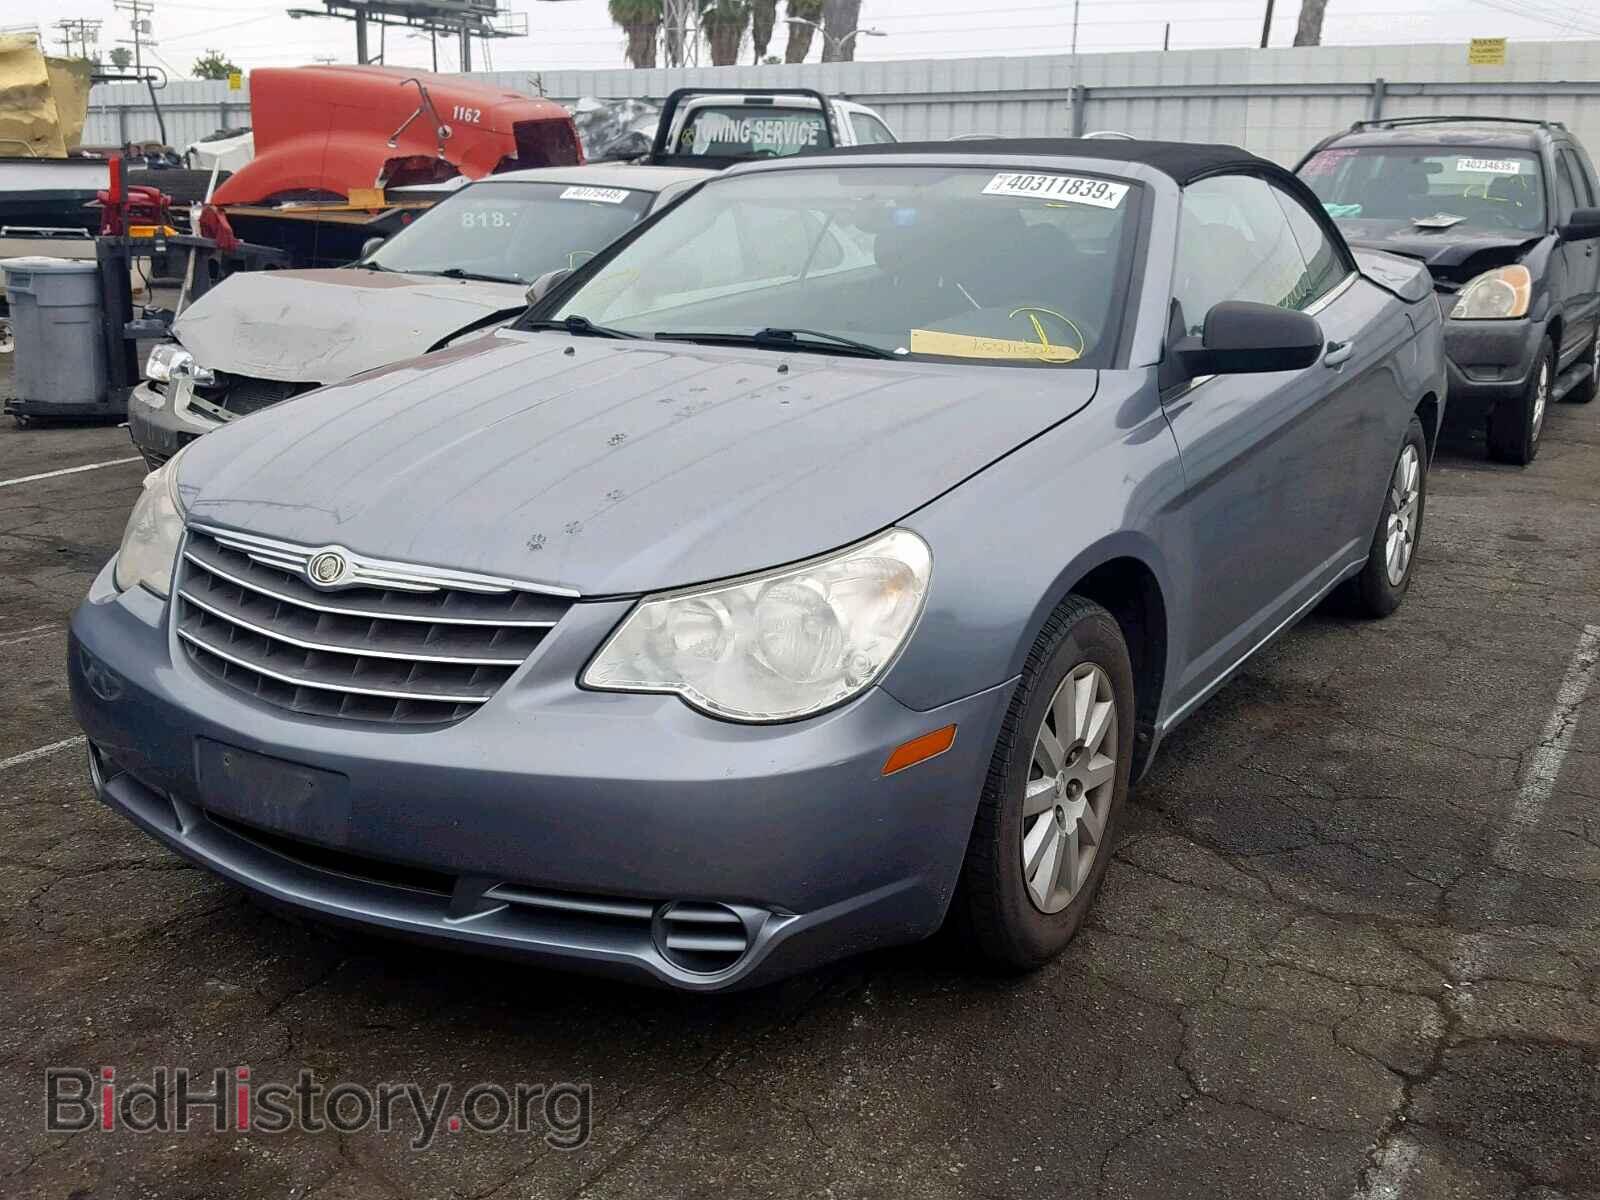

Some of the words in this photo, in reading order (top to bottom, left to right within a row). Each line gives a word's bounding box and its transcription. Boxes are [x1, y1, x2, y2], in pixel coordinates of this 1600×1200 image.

[453, 105, 481, 123] 1162
[694, 118, 750, 144] TOWING
[755, 119, 819, 146] SERVICE
